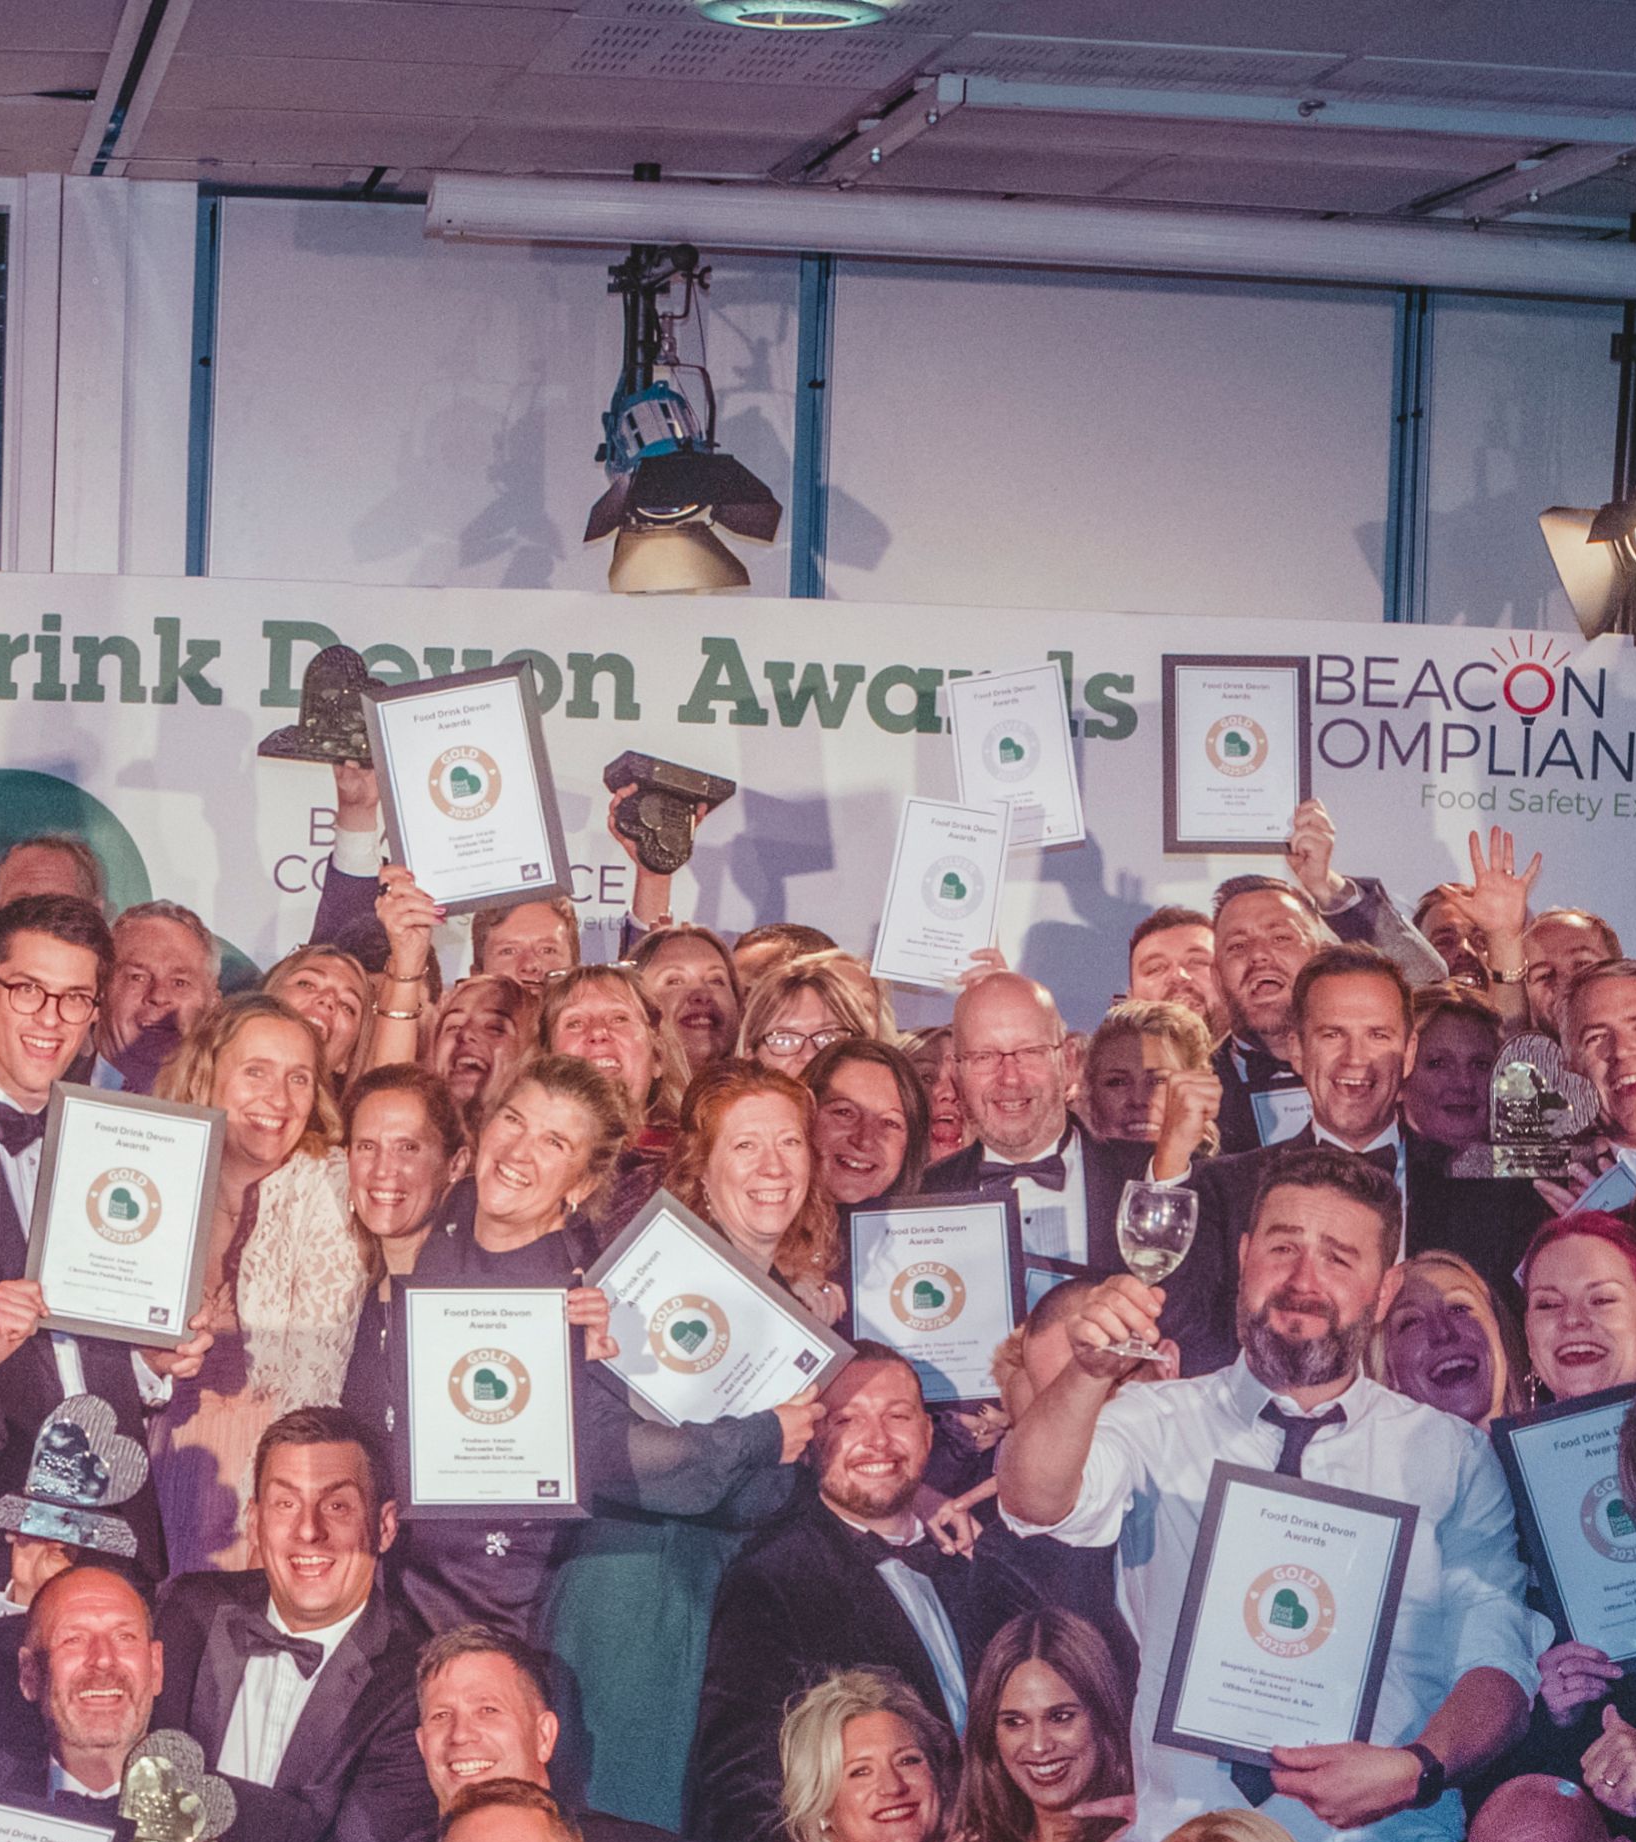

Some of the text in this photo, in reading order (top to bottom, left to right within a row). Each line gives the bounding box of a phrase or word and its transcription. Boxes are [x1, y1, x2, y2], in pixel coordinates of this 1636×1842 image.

[1315, 654, 1606, 718] BEACON
[1421, 784, 1497, 812] Food
[1509, 788, 1602, 822] Safety
[442, 1307, 532, 1317] Food Drink Devon
[468, 1320, 508, 1330] Awards
[465, 1349, 512, 1366] GOLD
[463, 1406, 515, 1423] 2025/26
[1259, 1507, 1357, 1538] Food Drink Devon
[1283, 1529, 1327, 1548] Awards
[1271, 1567, 1321, 1590] GOLD
[1252, 1634, 1310, 1656] 2025/26
